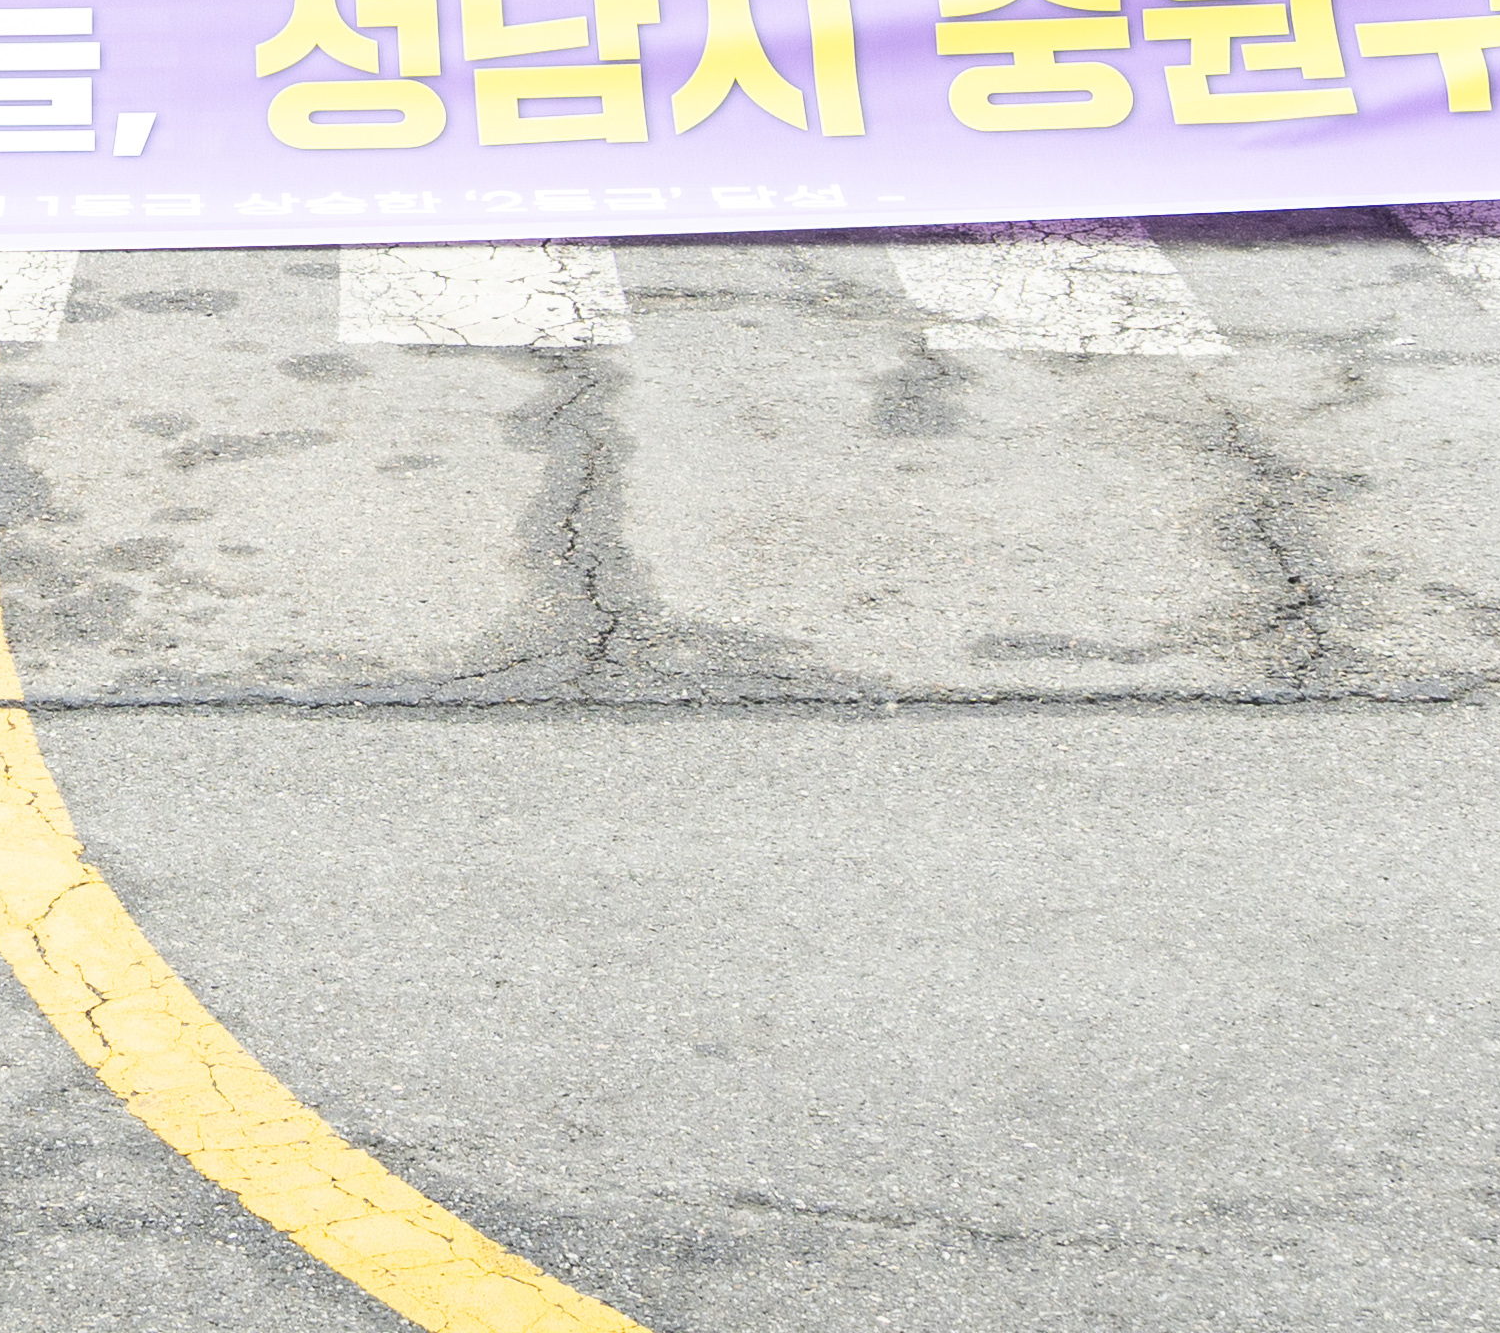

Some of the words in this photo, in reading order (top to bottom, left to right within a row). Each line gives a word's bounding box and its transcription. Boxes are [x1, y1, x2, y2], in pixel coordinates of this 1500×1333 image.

[36, 193, 206, 219] 1등급
[233, 189, 442, 217] 상승한
[711, 182, 848, 210] 달성
